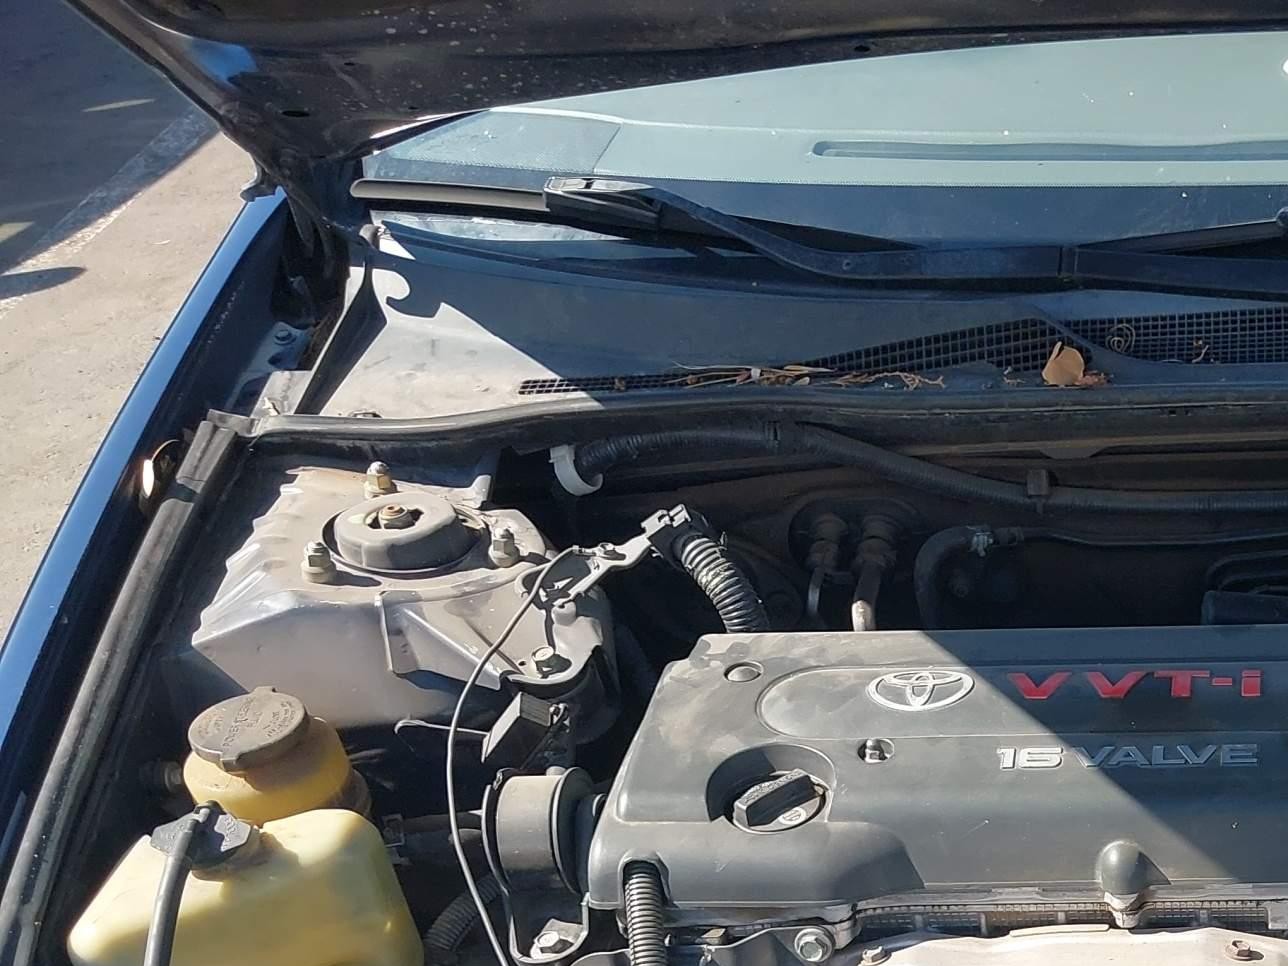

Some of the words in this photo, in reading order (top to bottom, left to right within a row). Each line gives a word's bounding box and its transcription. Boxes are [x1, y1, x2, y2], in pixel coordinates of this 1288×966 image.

[1007, 669, 1262, 700] VVT-i
[997, 746, 1064, 770] 16
[1071, 743, 1259, 768] VALVE
